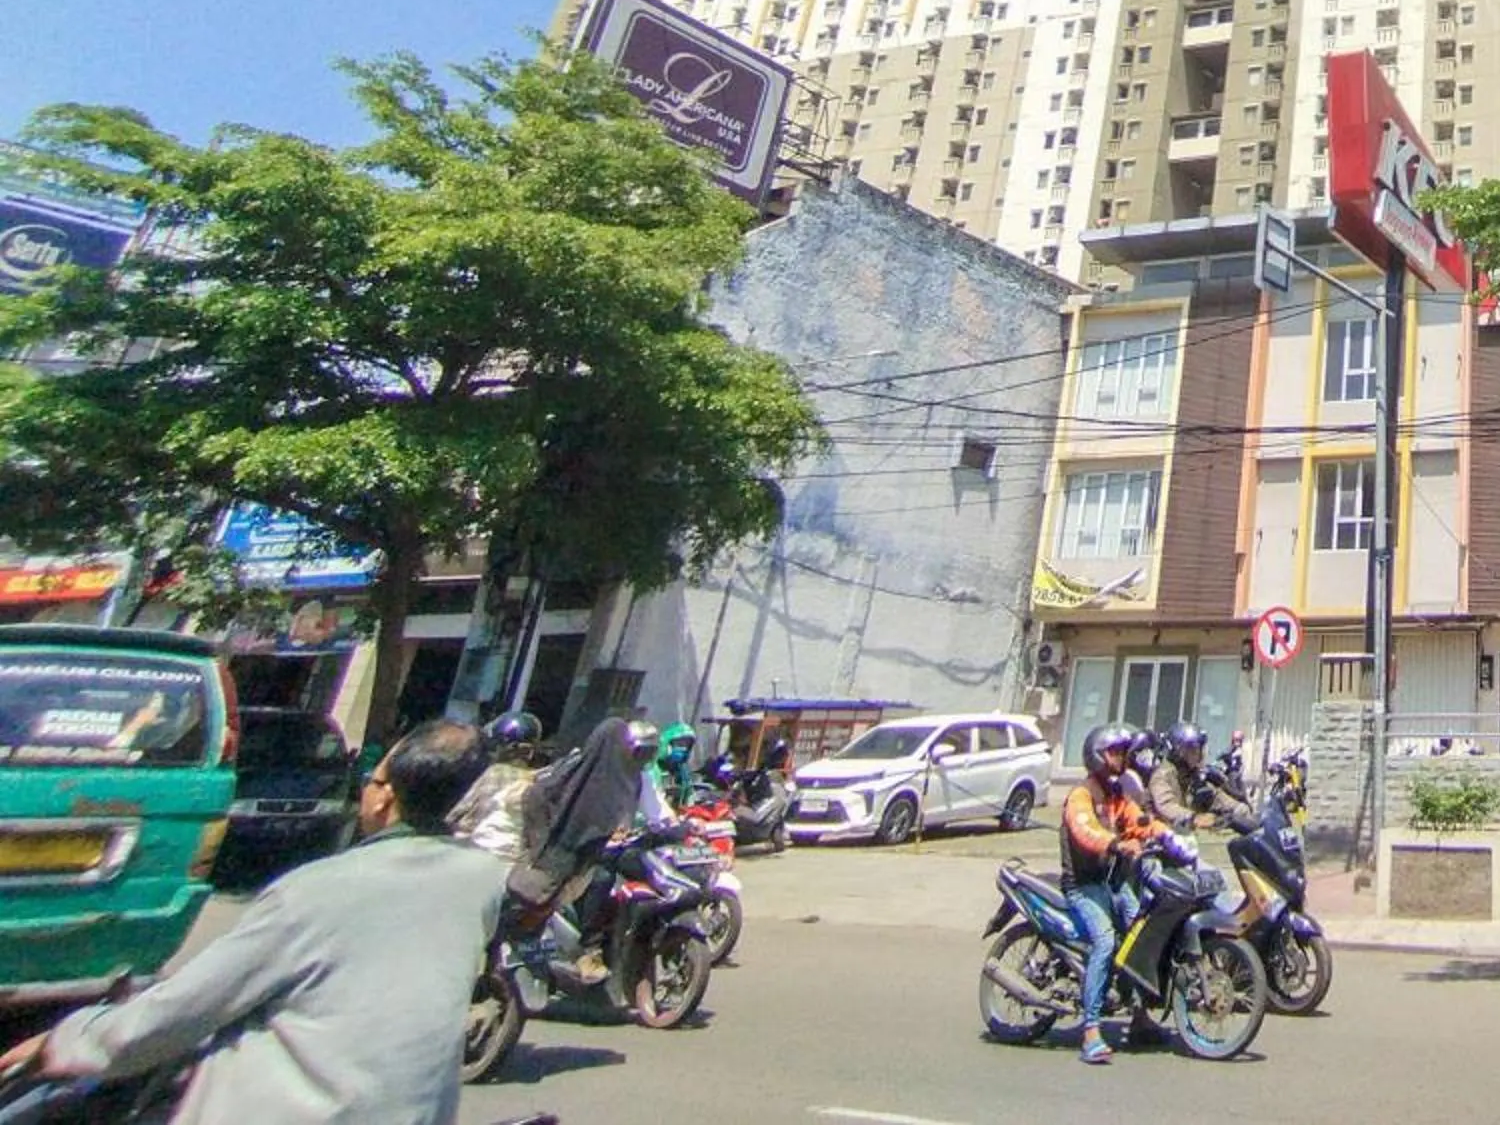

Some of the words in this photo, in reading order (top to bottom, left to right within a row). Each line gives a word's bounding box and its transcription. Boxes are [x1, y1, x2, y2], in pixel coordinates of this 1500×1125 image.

[623, 68, 665, 94] LADY
[717, 126, 742, 145] USA
[1269, 620, 1291, 656] P
